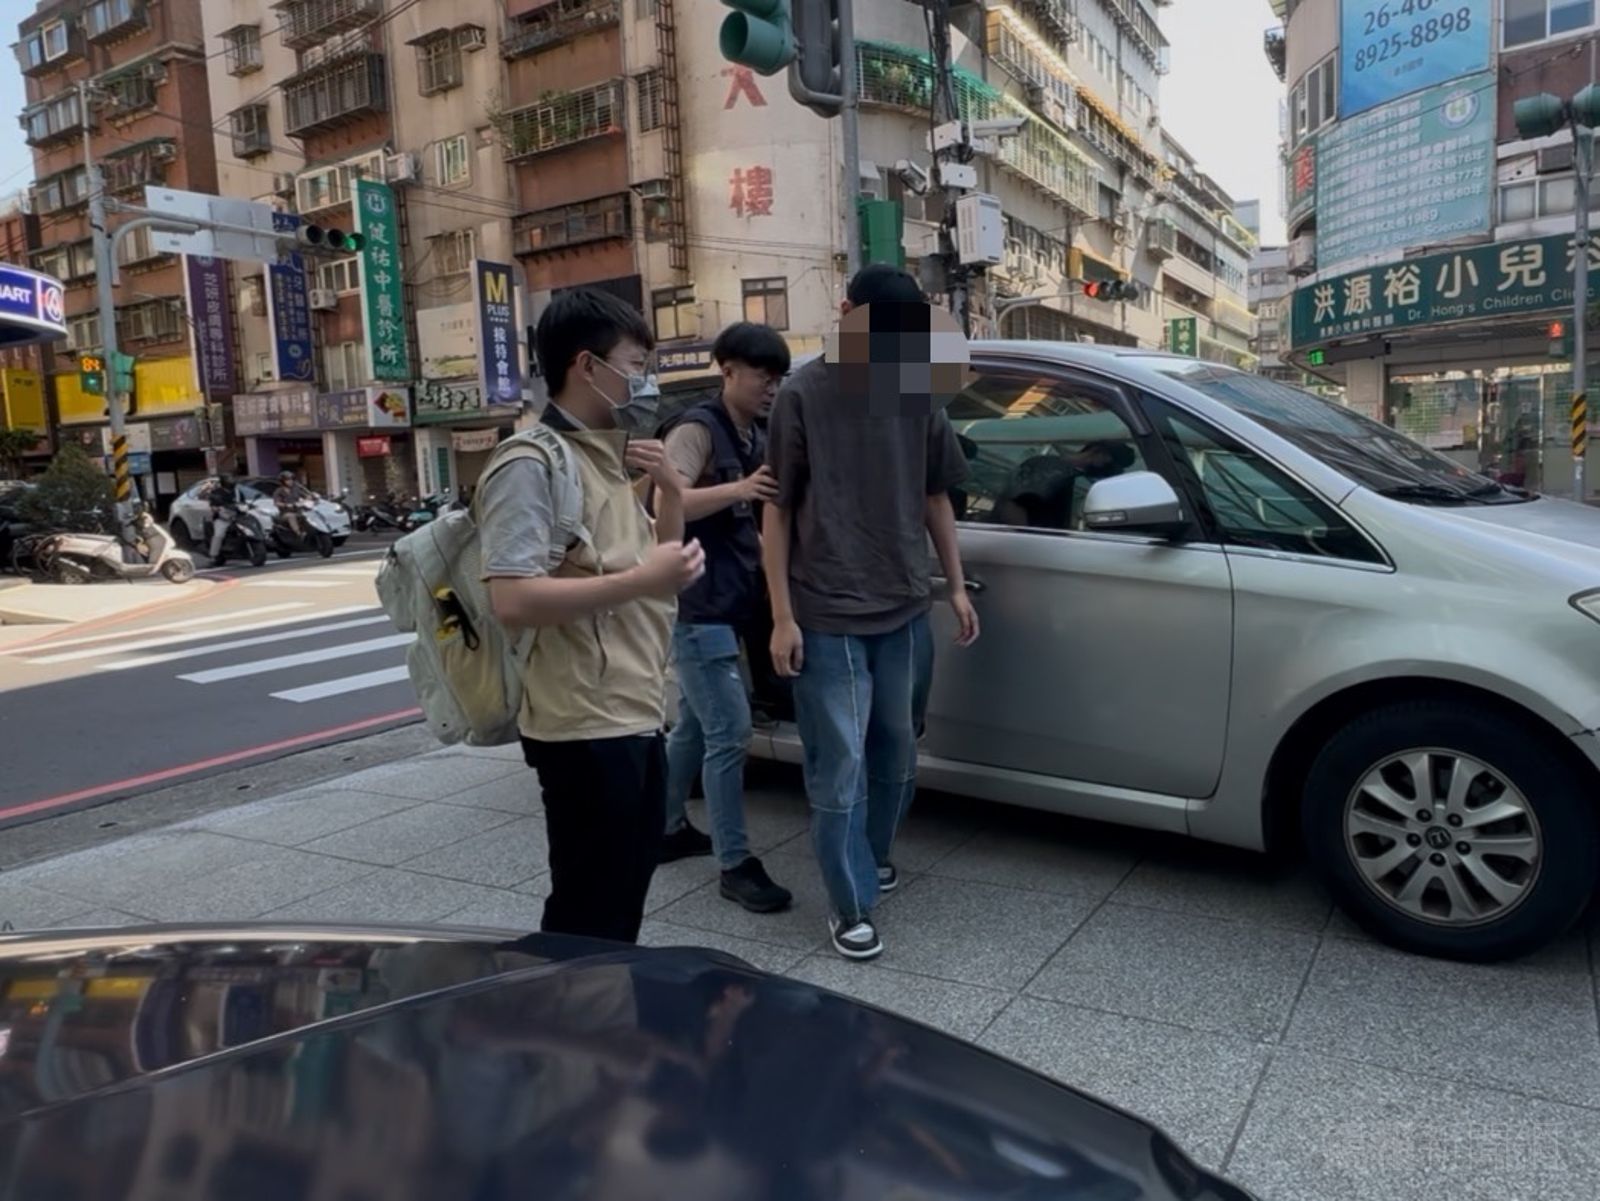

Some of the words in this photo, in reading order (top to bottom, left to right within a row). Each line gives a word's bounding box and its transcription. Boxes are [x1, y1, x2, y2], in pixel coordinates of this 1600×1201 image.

[1354, 7, 1471, 72] 8925-8898
[0, 284, 32, 305] ART
[484, 271, 509, 304] M
[1407, 308, 1425, 321] Dr.
[1430, 302, 1477, 318] Hong's
[1482, 292, 1544, 310] Children
